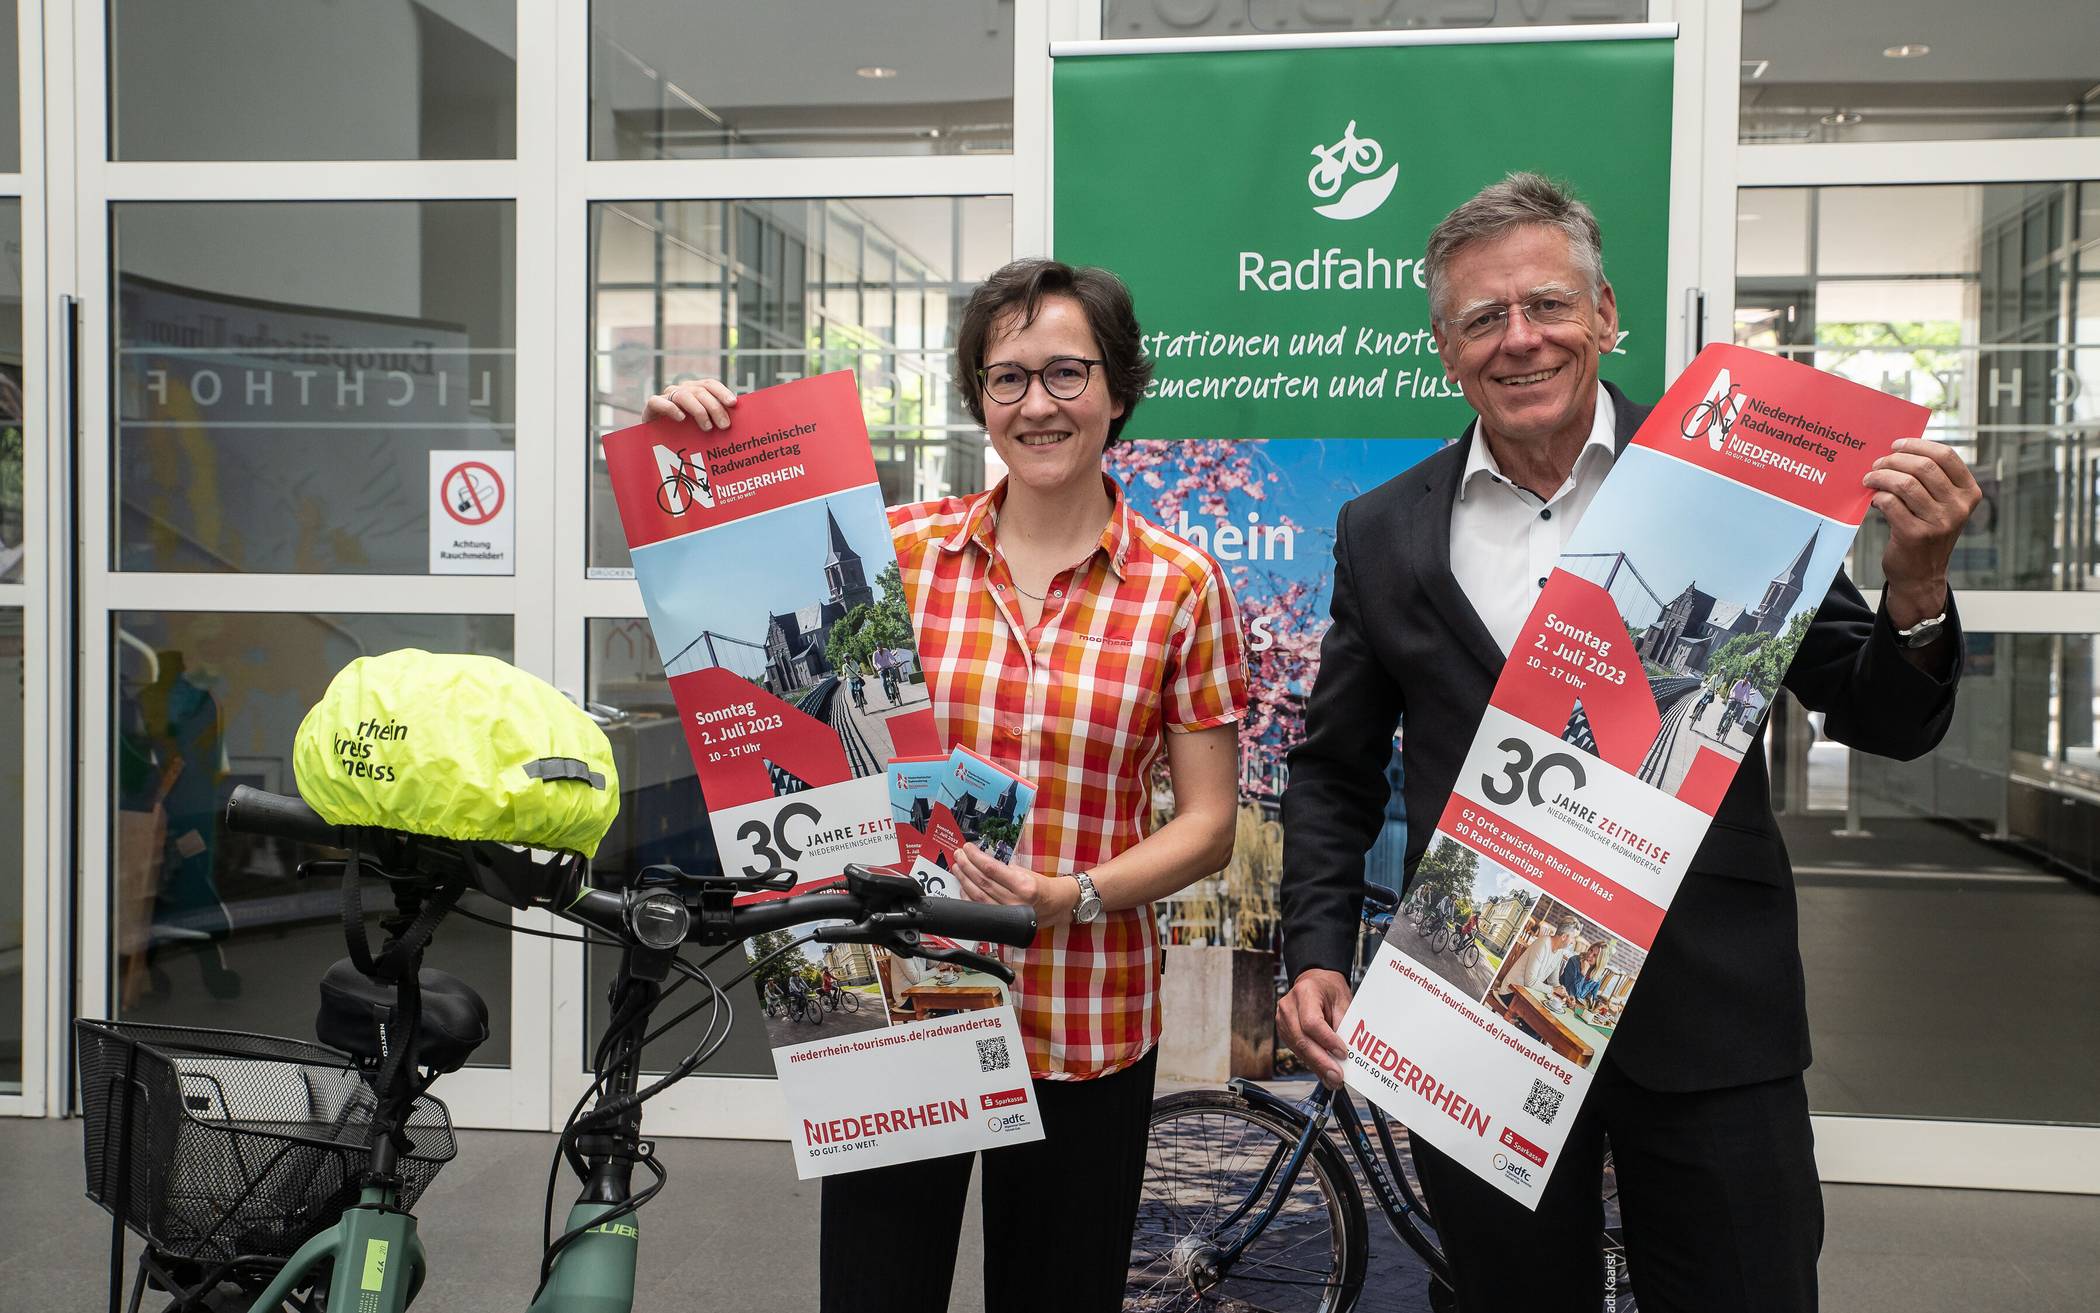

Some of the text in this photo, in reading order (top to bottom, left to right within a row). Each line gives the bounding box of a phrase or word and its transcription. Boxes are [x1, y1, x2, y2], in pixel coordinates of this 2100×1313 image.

[1239, 248, 1428, 291] Radfahre
[1140, 326, 1630, 358] stationen und Knote z
[1142, 367, 1464, 400] emenrouten und Fluss
[707, 422, 817, 461] Niederrheinischer
[1740, 414, 1838, 463] Radwandertag
[1747, 398, 1867, 451] Niederrheinischer
[711, 443, 801, 477] Radwandertag
[1727, 434, 1827, 485] NIEDERRHEIN
[715, 463, 806, 500] NIEDERRHEIN
[453, 540, 492, 551] Achtung
[1159, 510, 1295, 561] hein
[1544, 613, 1612, 657] Sonntag
[1526, 655, 1541, 669] 10
[1549, 666, 1564, 679] 17
[1565, 673, 1587, 690] Uhr
[1534, 633, 1627, 685] 2. Juli 2023
[356, 718, 408, 741] rhein
[695, 701, 757, 726] Sonntag
[701, 715, 783, 745] 2. Juli 2023
[334, 732, 373, 759] kreis
[708, 752, 721, 762] 10
[730, 747, 742, 759] 17
[743, 742, 761, 755] Uhr
[341, 757, 396, 782] neuss
[1481, 737, 1587, 807] 30
[736, 802, 823, 878] 30
[806, 817, 893, 847] JAHRE ZEIT
[809, 832, 898, 857] NIEDERRHEINISCHER RAD
[1547, 807, 1663, 876] NIEDERRHEINISCHER RADWANDERTAG
[1551, 793, 1671, 865] JAHRE ZEITREISE
[1455, 822, 1545, 880] 90 Radroutentipps
[1461, 808, 1614, 902] 62 Orte zwischen Rhein und Maas
[790, 1016, 1002, 1064] niederrhein-tourismus.de/radwandertag
[1389, 957, 1573, 1086] niederrhein-tourismus.de/radwandertag
[1346, 1048, 1399, 1093] O GUT. SO WEIT.
[1348, 1018, 1492, 1138] NIEDERRHEIN
[995, 1096, 1024, 1106] Sparkasse
[1002, 1113, 1026, 1125] adfc
[803, 1097, 969, 1147] NIEDERRHEIN
[809, 1138, 879, 1158] SO GUT. SO WEIT.
[1513, 1141, 1542, 1163] Sparkasse
[1361, 1139, 1402, 1213] GAZELLE
[1507, 1162, 1531, 1182] adfc
[1604, 1294, 1616, 1313] adt
